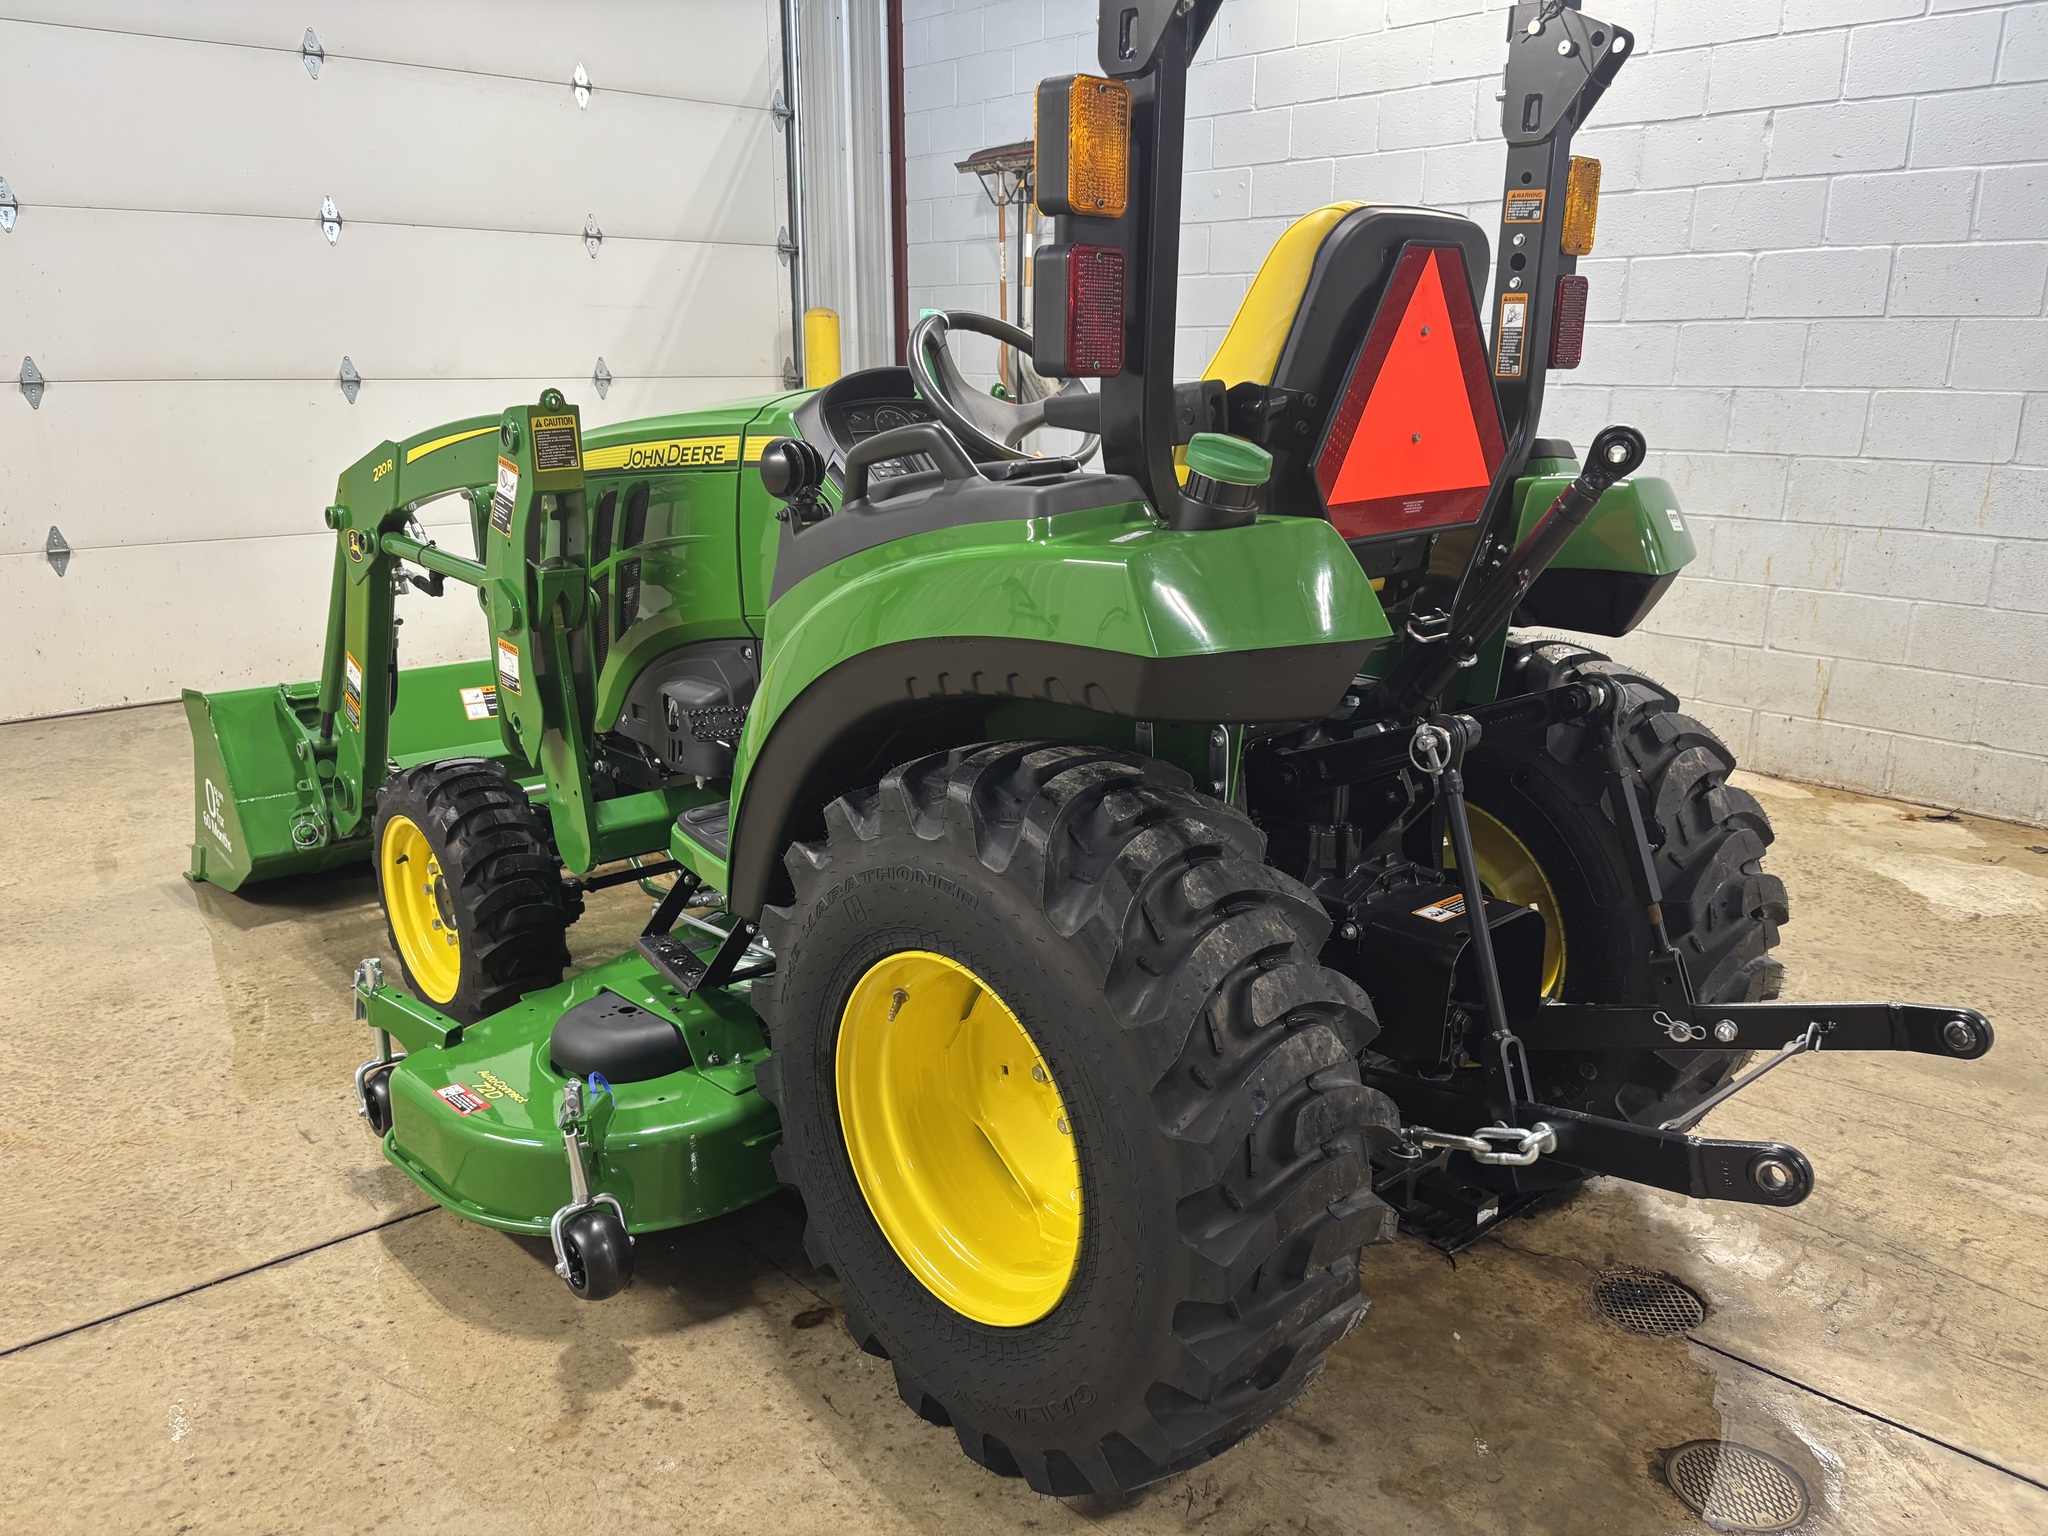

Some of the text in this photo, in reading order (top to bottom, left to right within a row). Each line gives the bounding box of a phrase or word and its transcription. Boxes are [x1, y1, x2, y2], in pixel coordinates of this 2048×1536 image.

[543, 416, 574, 427] CAUTION
[623, 444, 726, 467] JOHN DEERE
[211, 817, 233, 854] Months
[801, 864, 979, 939] MARATHONER
[470, 1080, 505, 1100] 72D
